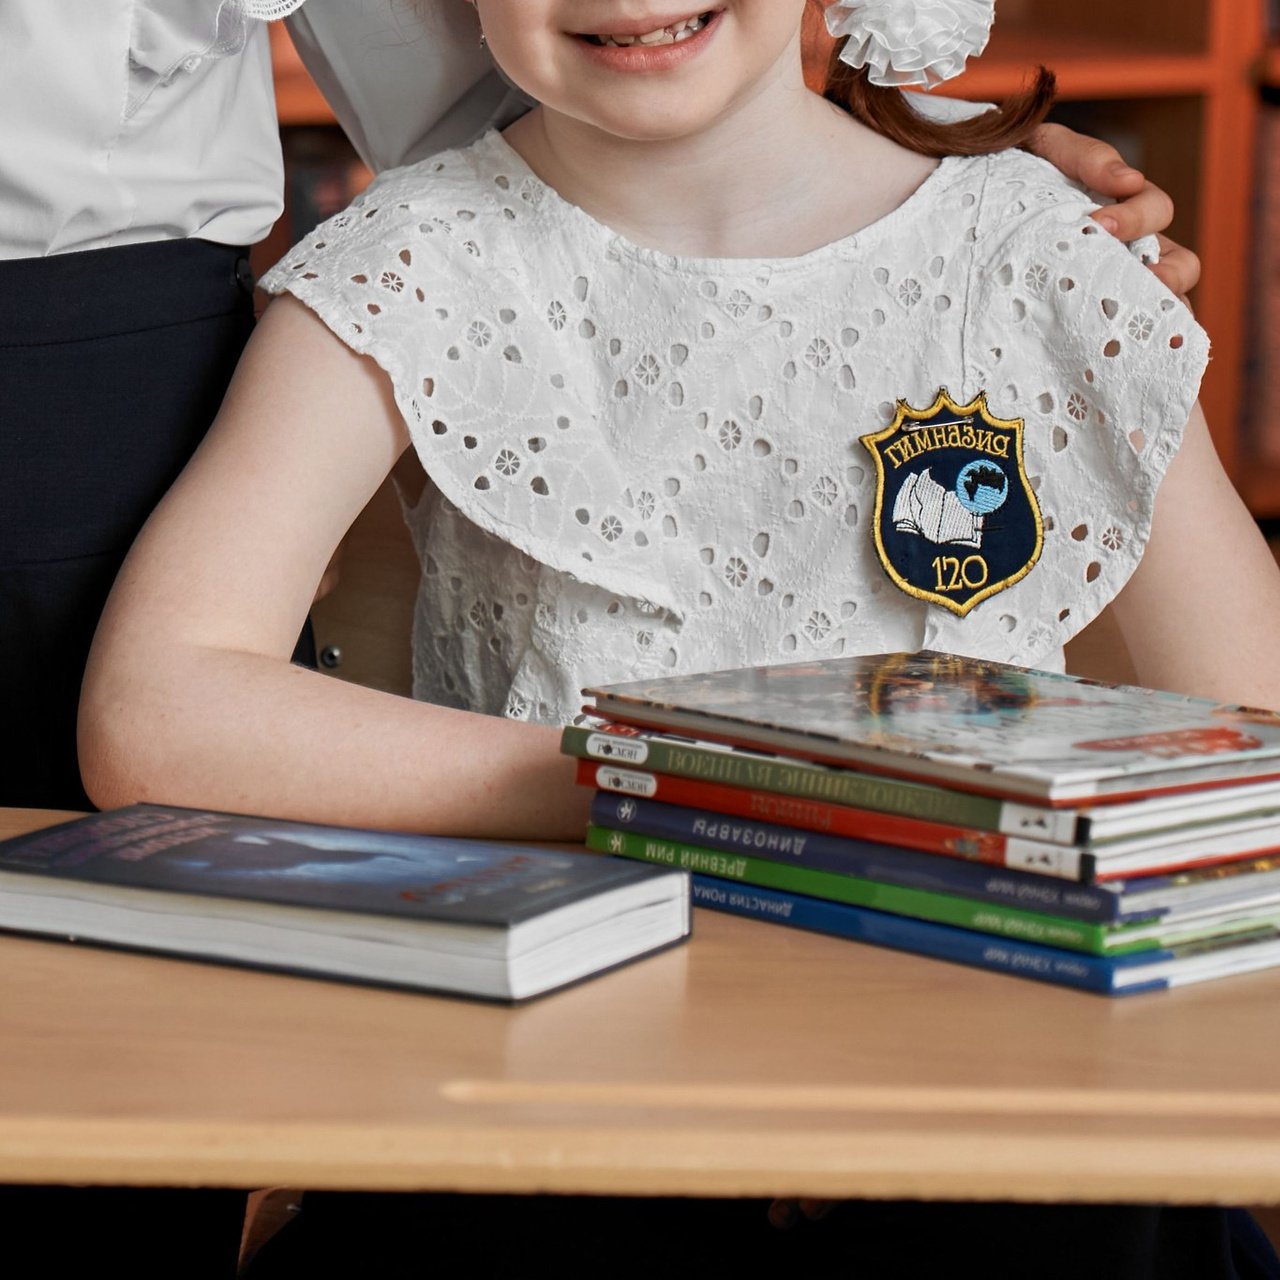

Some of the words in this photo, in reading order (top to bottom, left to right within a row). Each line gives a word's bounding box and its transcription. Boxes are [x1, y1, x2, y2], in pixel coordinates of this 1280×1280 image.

[931, 554, 989, 592] 120
[692, 817, 807, 856] ДИНОЗАВРЫ
[645, 842, 675, 863] РИМ
[680, 847, 747, 878] ДРЕВНИЙ
[694, 885, 727, 905] РОМА
[729, 892, 794, 918] ДИНАСТИЯ
